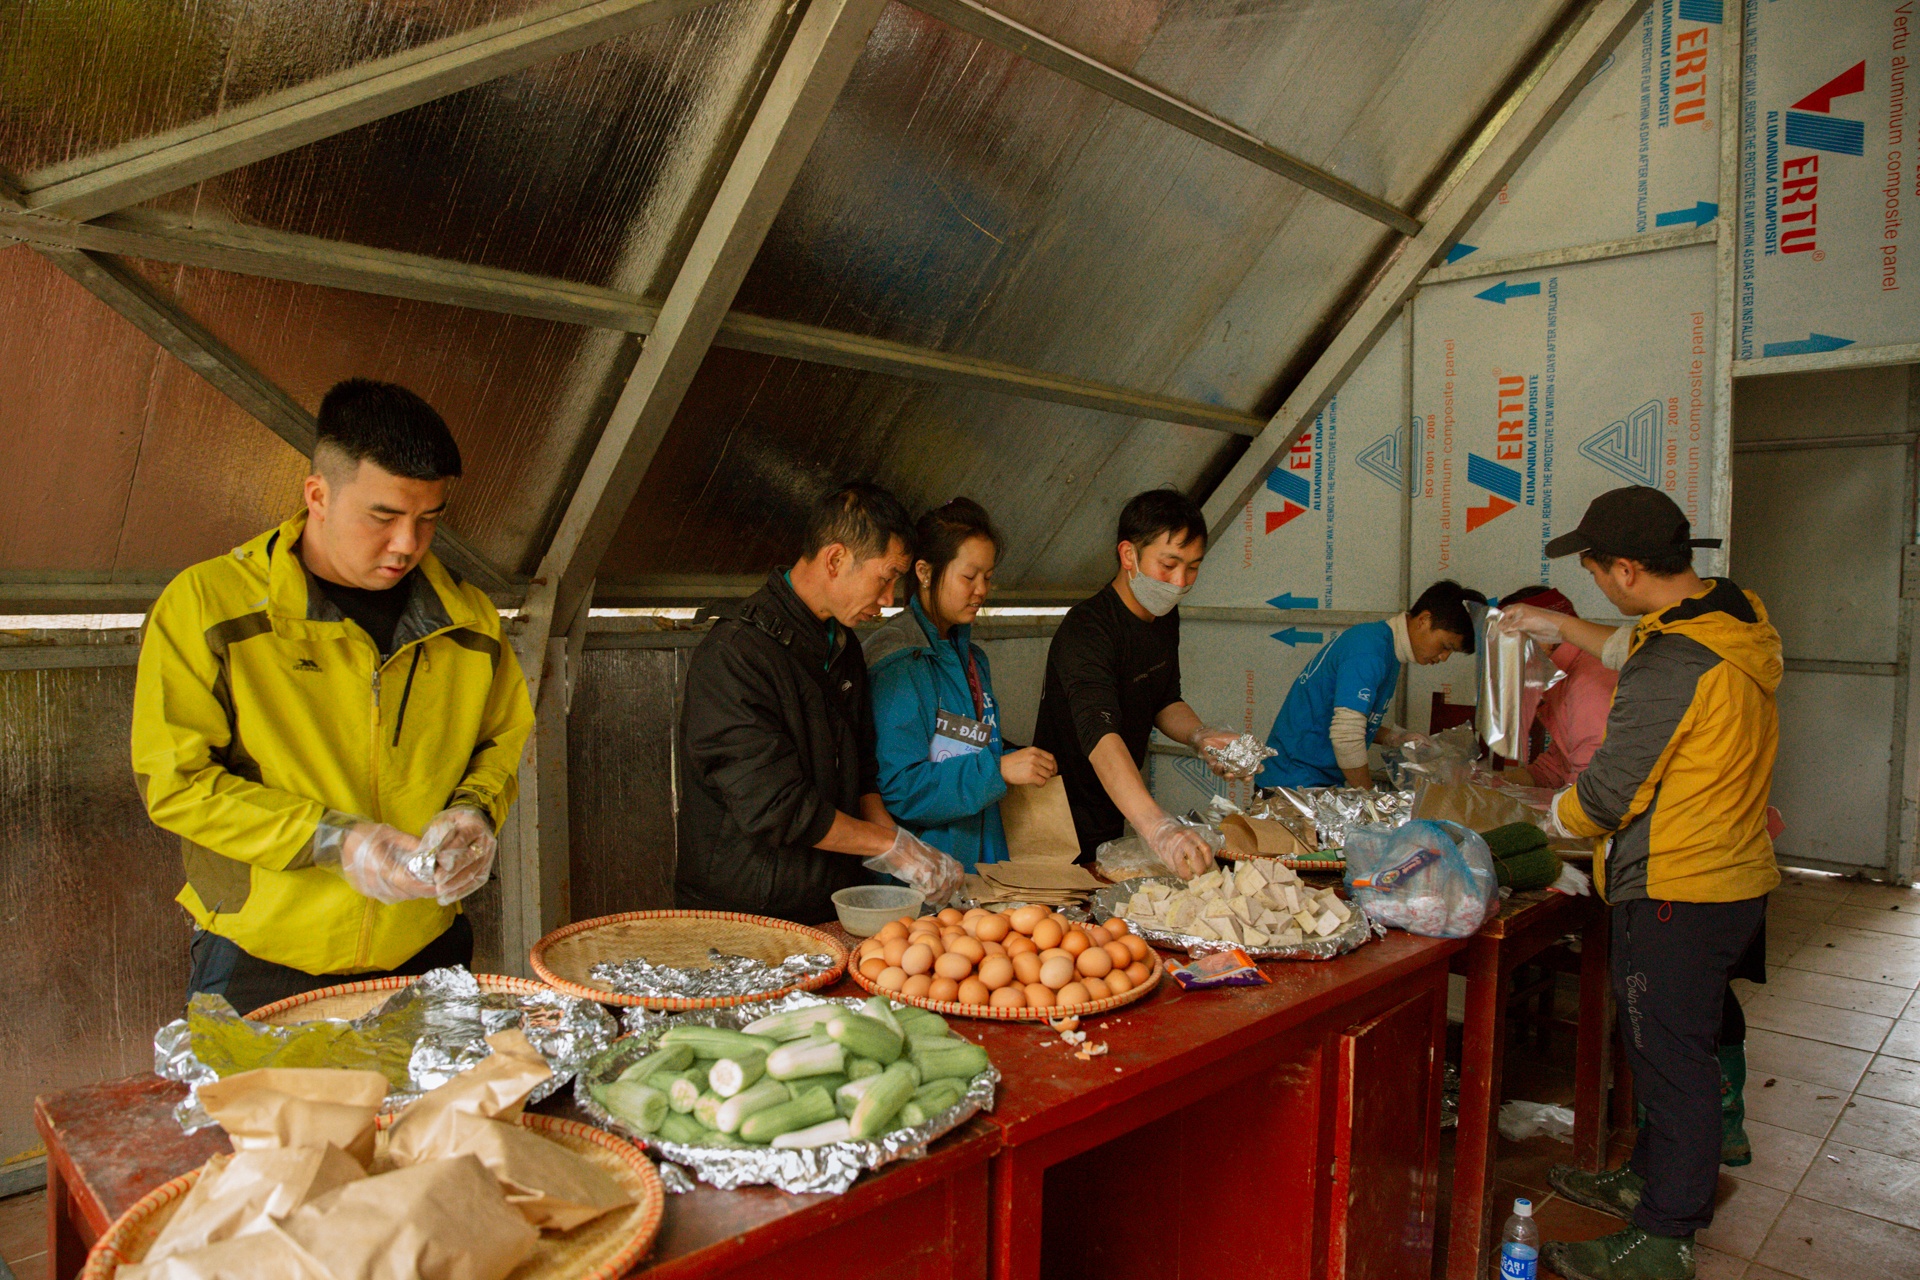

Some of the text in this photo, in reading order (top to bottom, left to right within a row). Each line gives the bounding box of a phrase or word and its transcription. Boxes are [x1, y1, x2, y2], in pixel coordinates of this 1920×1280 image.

[1641, 28, 1653, 73] PROTECTIVE
[1658, 0, 1673, 129] UMINIUM COMPOSITE
[1639, 94, 1651, 120] WITHIN
[1744, 101, 1756, 133] REMOVE
[1638, 132, 1649, 153] DAYS
[1744, 134, 1756, 150] THE
[1880, 1, 1913, 291] Vertu aluminium composite panel
[1637, 154, 1648, 178] AFTER
[1743, 152, 1756, 200] PROTECTIVE
[1764, 110, 1779, 257] ALUMINIUM COMPOSITE
[1636, 180, 1647, 233] INSTALLATION
[1743, 201, 1755, 219] FILM
[1743, 220, 1755, 247] WITHIN
[1742, 259, 1754, 280] DAYS
[1548, 277, 1558, 328] INSTALLATION
[1742, 281, 1754, 306] AFTER
[1547, 329, 1557, 352] AFTER
[1690, 311, 1706, 355] panel
[1741, 308, 1754, 359] INSTALLATIO
[1546, 353, 1556, 373] DAYS
[1545, 384, 1555, 410] WITHIN
[1667, 396, 1679, 425] 2008
[1687, 360, 1703, 443] composite
[1329, 425, 1337, 440] FILM
[1426, 413, 1436, 440] 2008
[1545, 411, 1555, 427] FILM
[1526, 374, 1539, 506] ALUMINIUM COMPOSITE
[1543, 428, 1554, 472] PROTECTIVE
[1666, 438, 1678, 467] 9001
[1313, 413, 1324, 511] ALUMINIUM COMPO
[1327, 441, 1337, 481] PROTECTIVE
[1426, 450, 1435, 476] 9001
[1438, 338, 1456, 571] Vertu aluminium composite panel
[1327, 482, 1336, 494] THE
[1425, 477, 1434, 498] ISO
[1543, 473, 1553, 488] THE
[1665, 473, 1676, 492] ISO
[1327, 496, 1335, 522] REMOVE
[1542, 489, 1552, 519] REMOVE
[1243, 536, 1253, 570] Vertu
[1326, 541, 1334, 561] RIGHT
[1325, 582, 1333, 609] INSTALL
[1245, 669, 1256, 704] panel
[959, 724, 988, 743] ĐẦU
[1502, 1256, 1525, 1270] CARI
